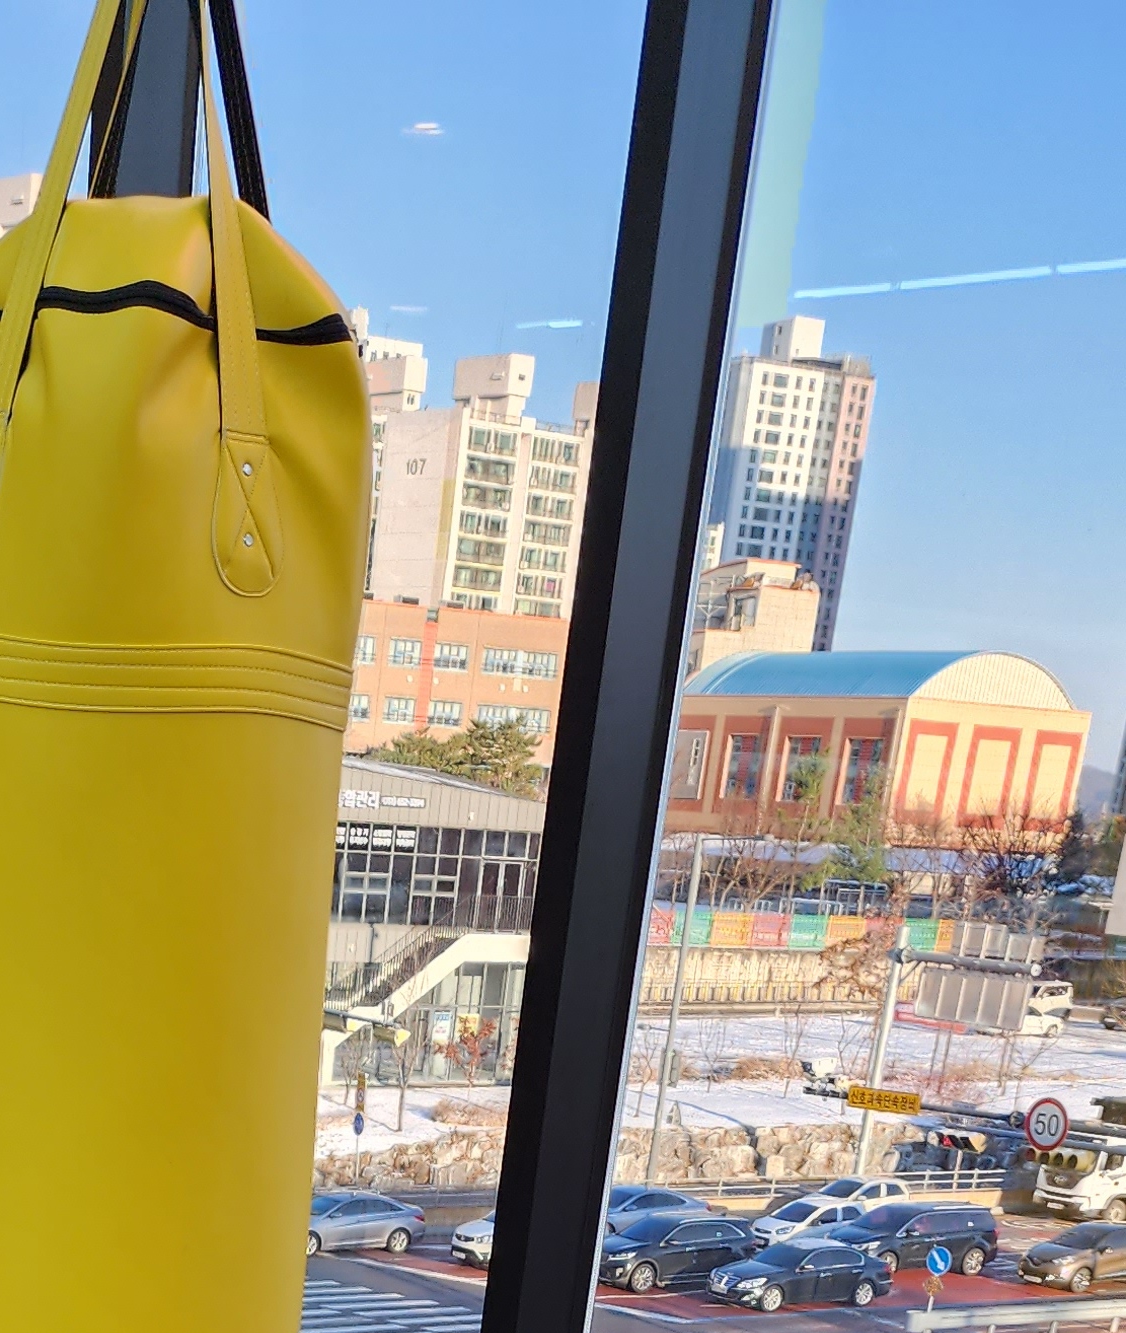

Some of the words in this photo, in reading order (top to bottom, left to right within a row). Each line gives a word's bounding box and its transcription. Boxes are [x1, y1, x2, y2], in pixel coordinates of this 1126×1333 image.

[406, 458, 427, 475] 107
[850, 1089, 916, 1111] 신호과속단속장비
[1034, 1112, 1059, 1137] 50
